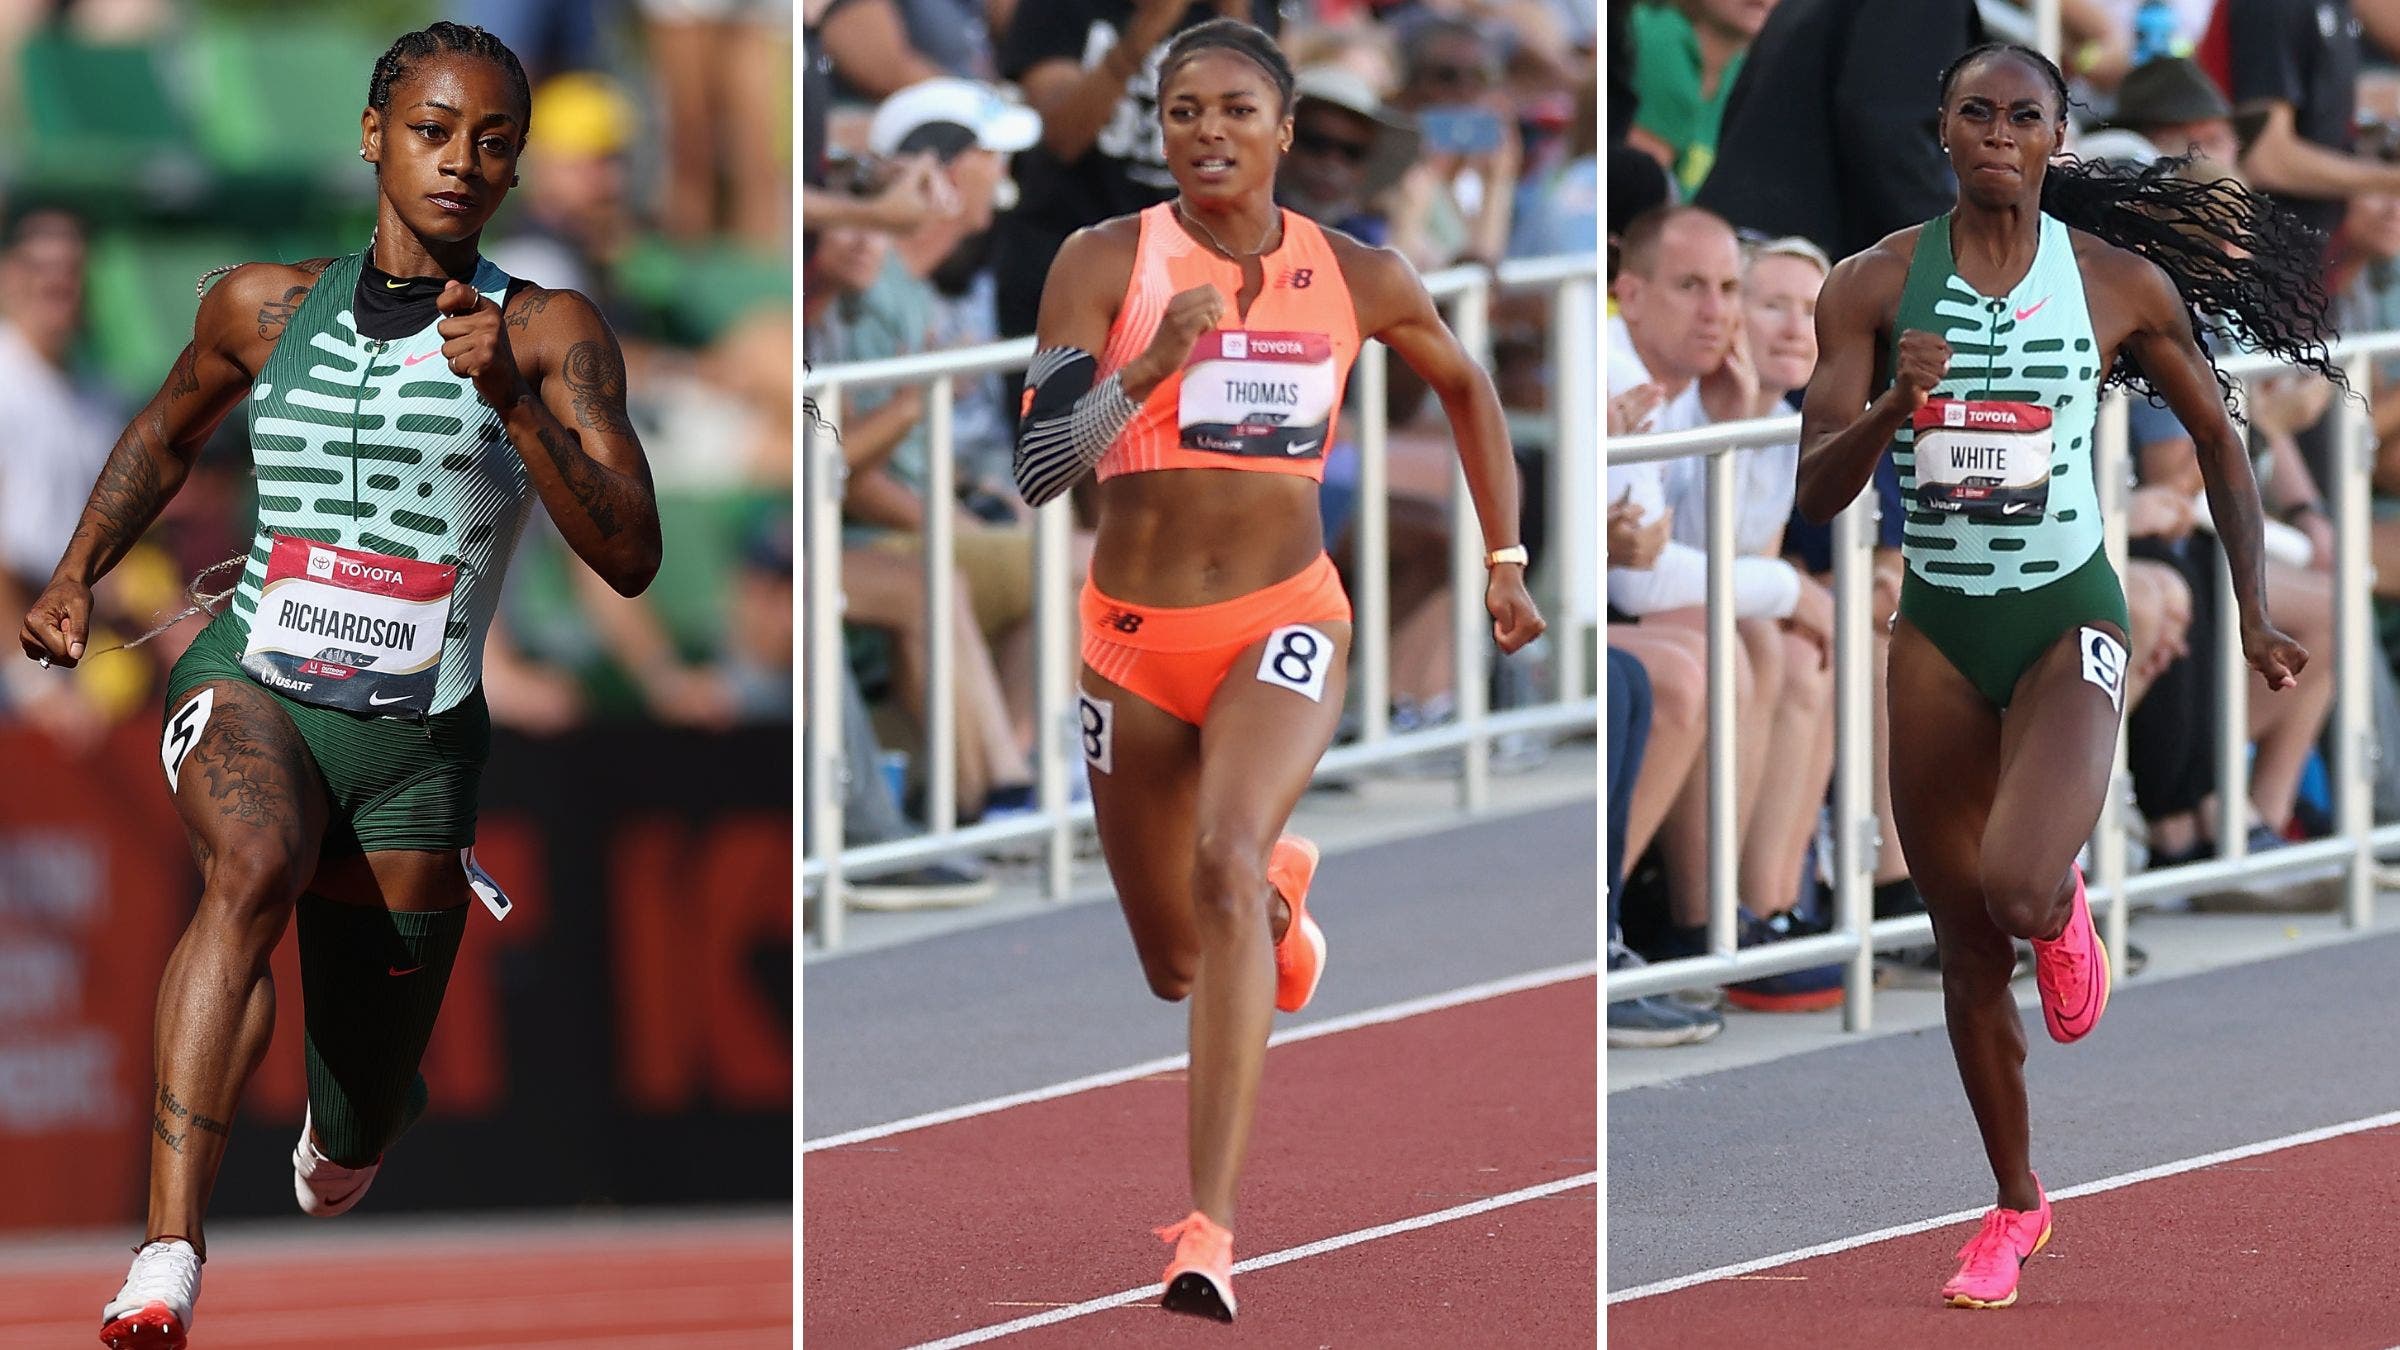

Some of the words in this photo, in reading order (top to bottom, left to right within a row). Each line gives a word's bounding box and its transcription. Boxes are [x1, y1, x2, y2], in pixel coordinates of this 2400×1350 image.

[1250, 341, 1304, 355] TOYOTA
[1225, 380, 1299, 406] THOMAS
[1968, 410, 2017, 424] TOYOTA
[1951, 446, 2007, 471] WHITE
[340, 561, 403, 585] TOYOTA
[278, 599, 417, 651] RICHARDSON
[1273, 631, 1318, 684] 8
[2091, 636, 2119, 691] 9
[275, 676, 313, 692] USATF
[170, 700, 199, 776] 5
[1080, 698, 1104, 760] 8
